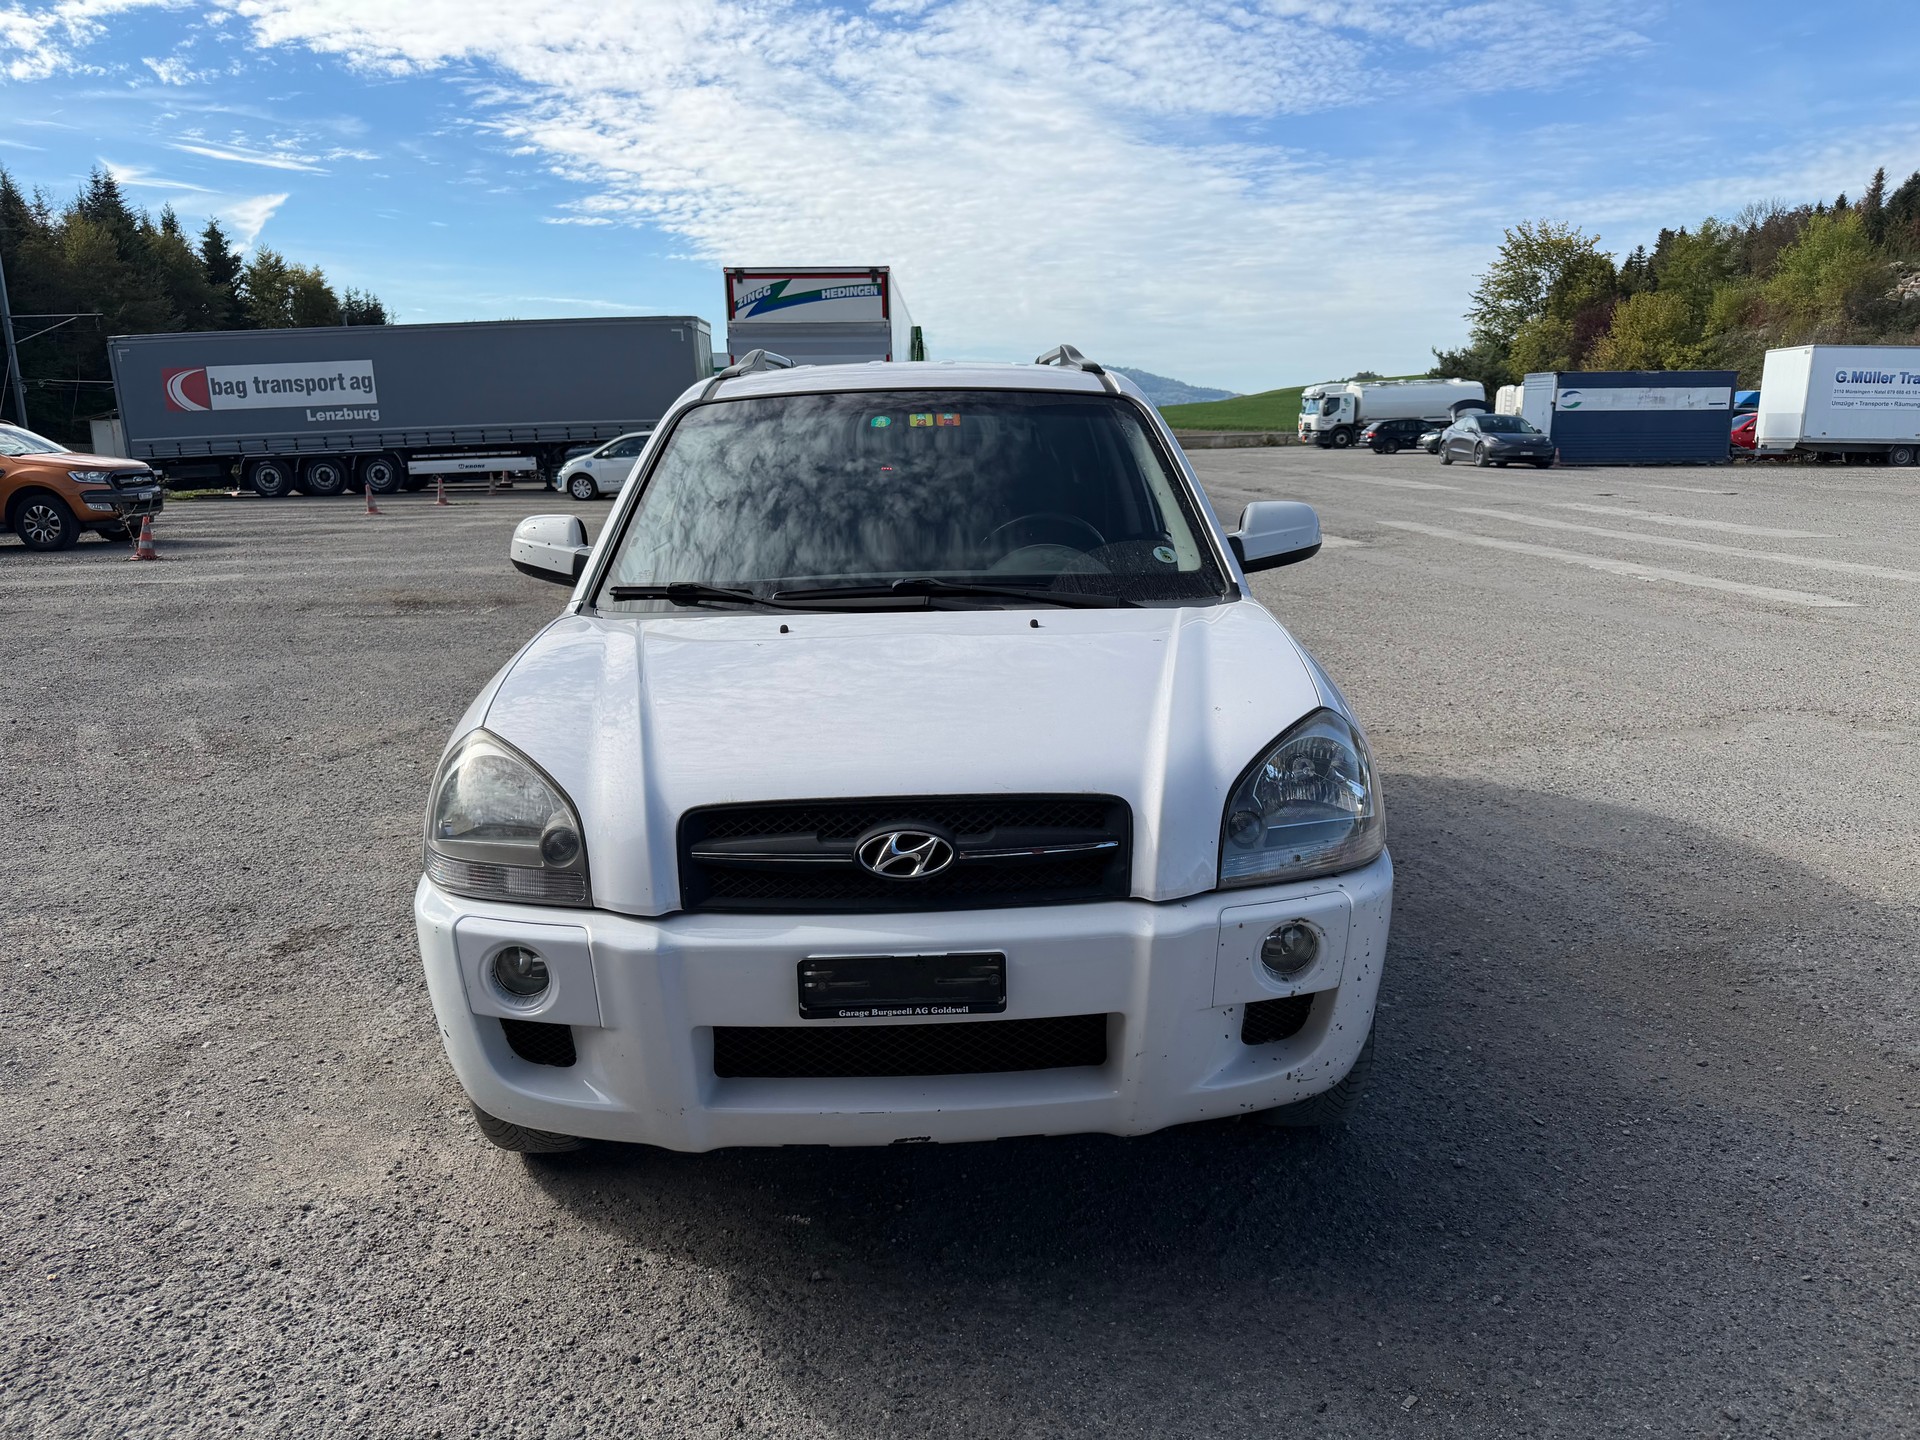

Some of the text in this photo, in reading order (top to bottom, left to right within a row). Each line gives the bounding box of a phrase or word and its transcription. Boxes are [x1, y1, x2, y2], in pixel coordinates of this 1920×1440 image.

[737, 285, 878, 308] ZINGG HEDINGEN
[1835, 370, 1896, 384] G.Müller
[210, 373, 374, 399] bag transport ag
[306, 408, 380, 421] Lenzburg
[839, 1009, 869, 1017] Garage
[871, 1008, 912, 1016] Burgseeli
[931, 1006, 969, 1014] Goldswil
